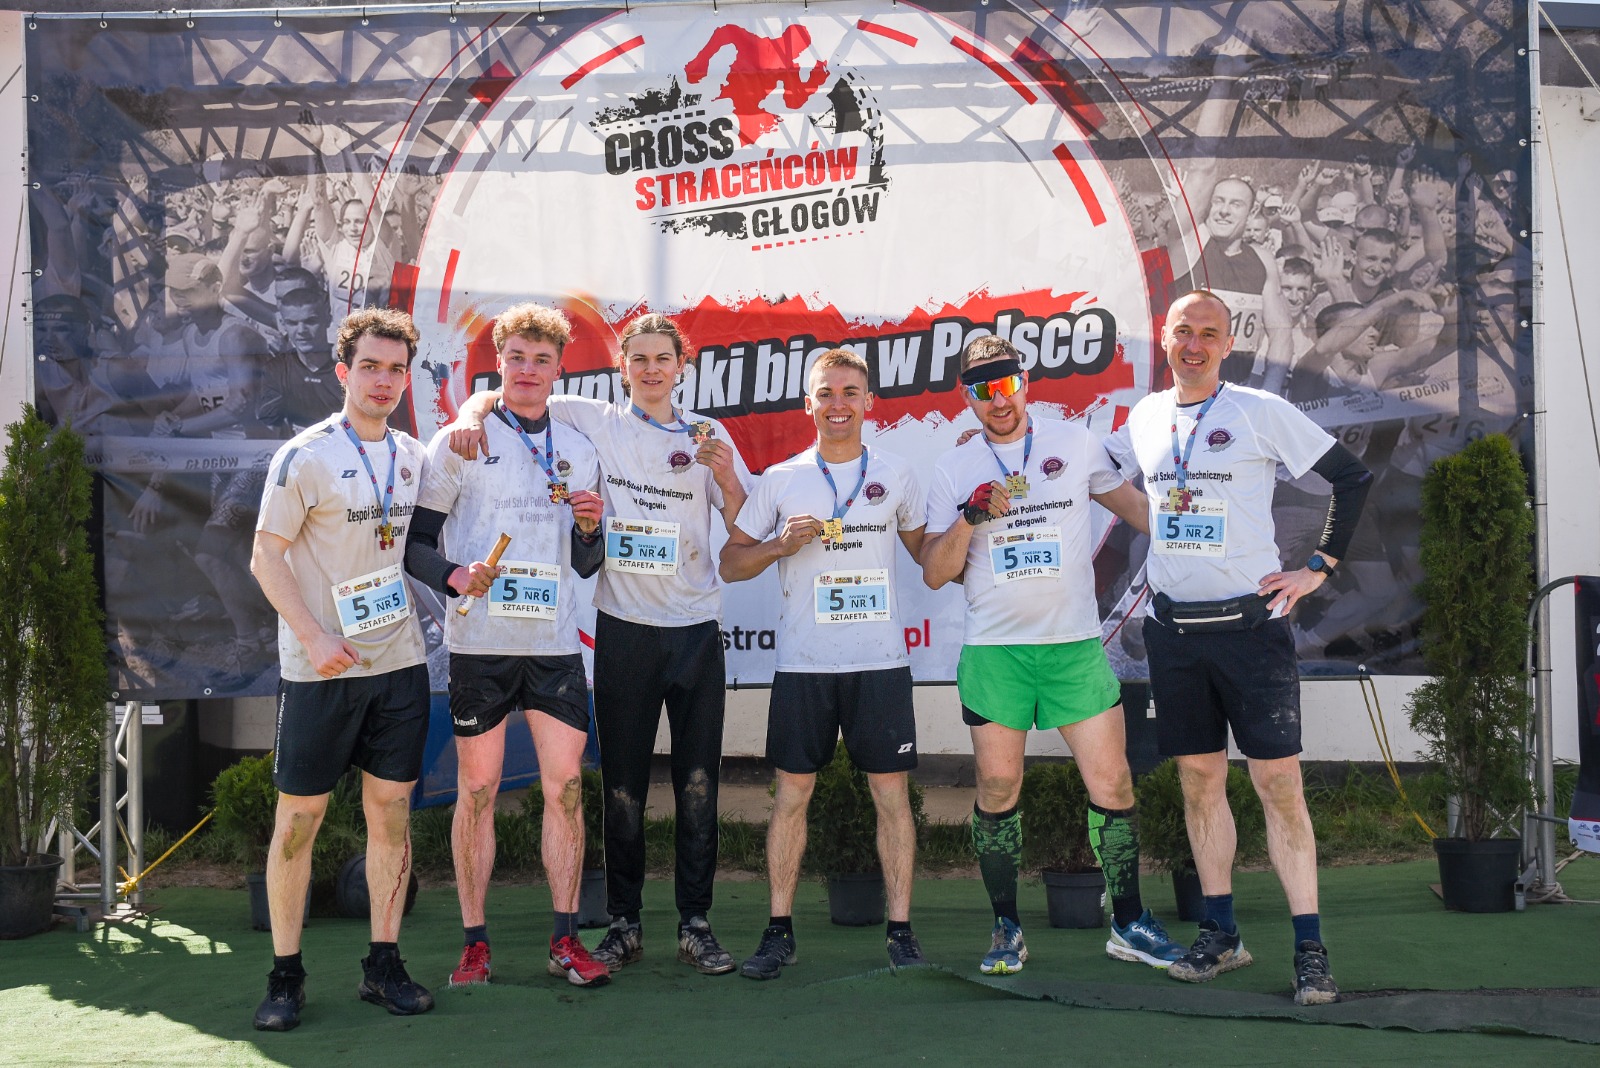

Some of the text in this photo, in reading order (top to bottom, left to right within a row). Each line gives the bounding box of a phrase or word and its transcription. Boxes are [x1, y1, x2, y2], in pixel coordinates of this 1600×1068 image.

[604, 117, 734, 175] CROSS
[635, 140, 859, 211] STRACEŃCÓW
[751, 188, 880, 238] GŁOGÓW
[670, 346, 745, 410] aki
[753, 340, 868, 403] bi
[878, 335, 922, 388] w
[1186, 469, 1233, 483] litechnicznych
[346, 504, 370, 525] Zespół
[1006, 521, 1014, 530] w
[1166, 516, 1180, 539] 5
[1186, 528, 1202, 538] NR
[1204, 525, 1214, 539] 2
[618, 535, 634, 558] 5
[639, 548, 655, 558] NR
[657, 546, 667, 559] 4
[824, 544, 831, 552] w
[1166, 541, 1202, 550] SZTAFETA
[618, 559, 655, 570] SZTAFETA
[1003, 546, 1019, 570] 5
[1024, 554, 1042, 564] NR
[1042, 550, 1053, 564] 3
[1006, 567, 1043, 580] SZTAFETA
[502, 578, 518, 602] 5
[524, 590, 540, 601] NR
[541, 589, 550, 603] 6
[375, 599, 393, 613] NR
[391, 591, 401, 607] 5
[829, 588, 845, 611] 5
[851, 598, 867, 609] NR
[868, 594, 877, 608] 1
[351, 595, 371, 621] 5
[502, 603, 541, 613] SZTAFETA
[358, 613, 397, 631] SZTAFETA
[830, 612, 869, 621] SZTAFETA
